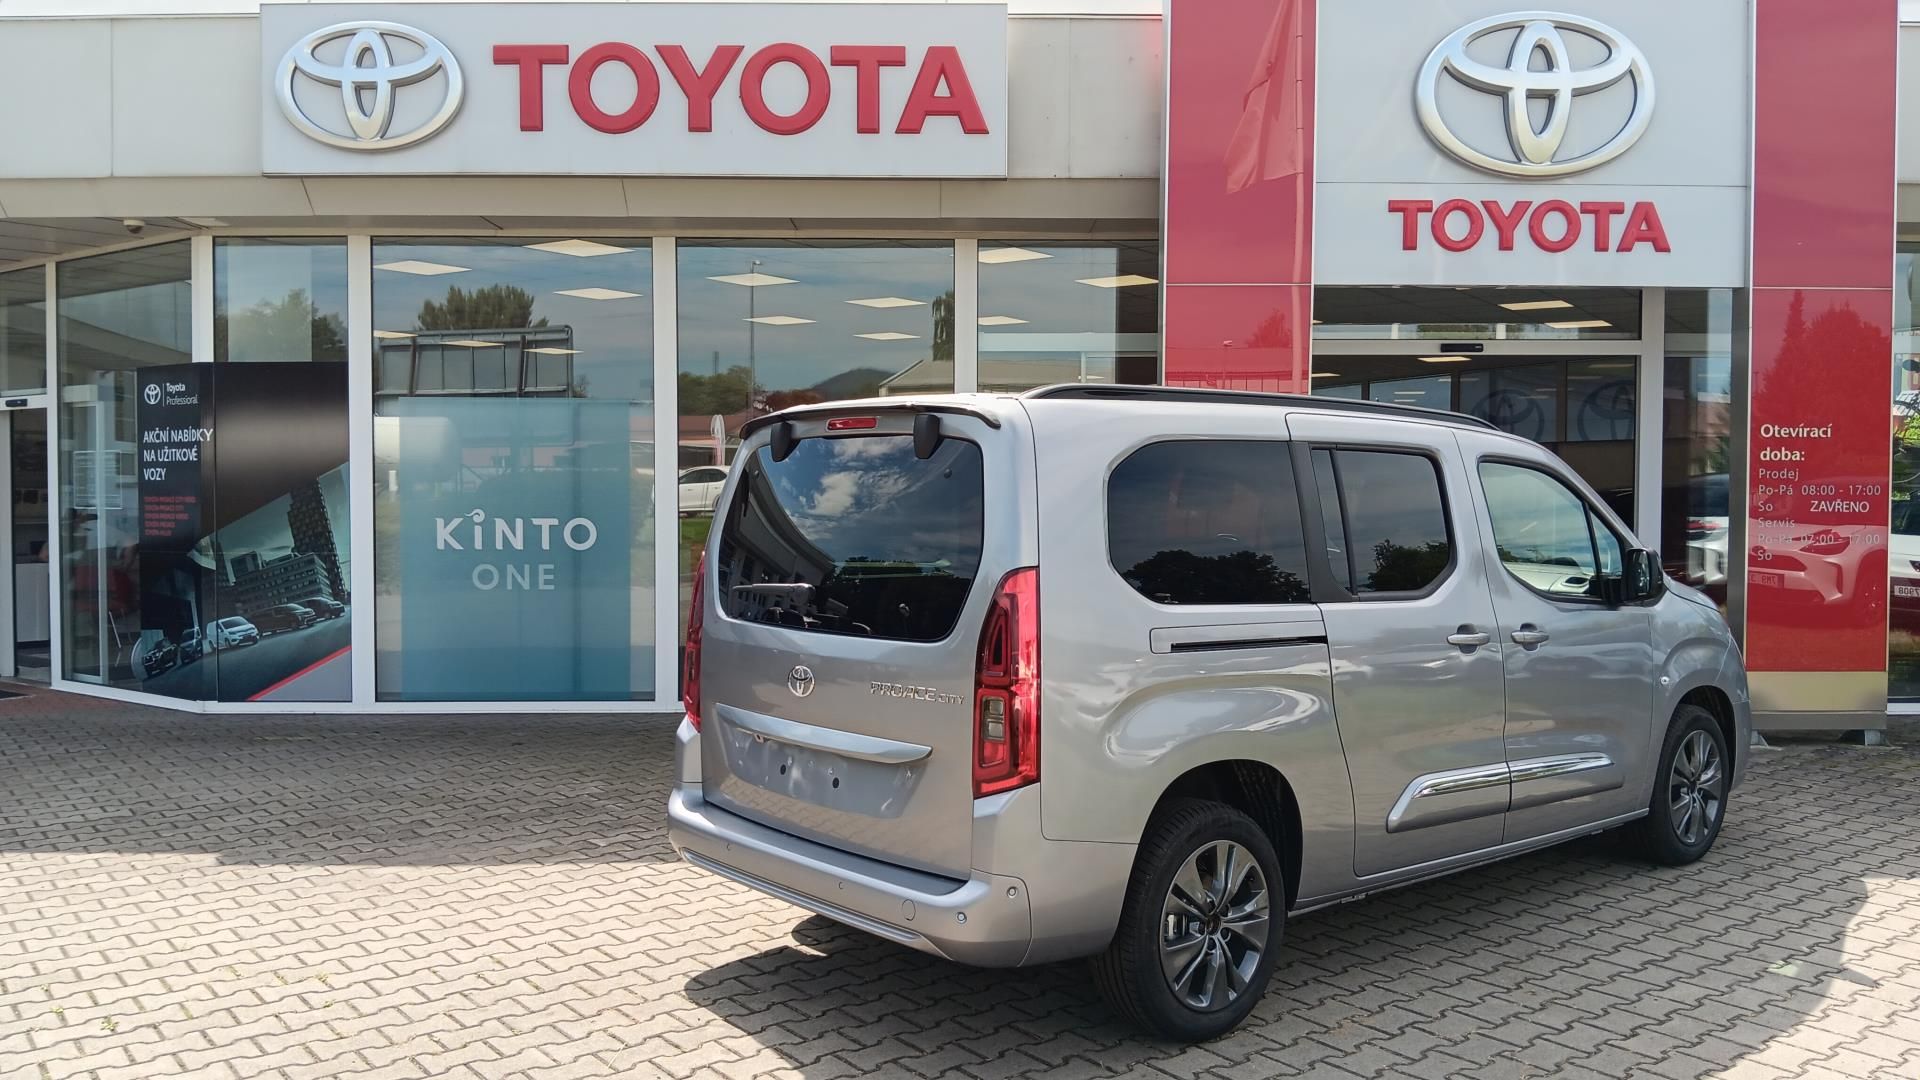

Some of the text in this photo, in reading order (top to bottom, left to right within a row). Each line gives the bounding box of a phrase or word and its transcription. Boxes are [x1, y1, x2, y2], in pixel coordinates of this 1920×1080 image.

[493, 42, 989, 135] TOYOTA
[1388, 198, 1672, 253] TOYOTA
[166, 383, 186, 393] Toyota
[166, 394, 199, 405] Professional
[143, 425, 214, 443] AKČNÍ NABÍDKY
[1760, 424, 1833, 438] Otevírací
[143, 445, 198, 462] NA UŽITKOVÉ
[1760, 447, 1805, 461] doba:
[143, 468, 166, 481] VOZY
[1759, 468, 1799, 481] Prodej
[1758, 485, 1793, 495] Po-Pá
[1801, 485, 1835, 496] 08:00
[1849, 485, 1881, 496] 17:00
[1758, 498, 1870, 513] So ZAVŘENO
[1758, 517, 1796, 528] Servis
[1801, 534, 1834, 545] 07:00
[1757, 549, 1773, 561] So
[472, 564, 555, 590] ONE
[870, 681, 965, 704] PROACE CITY
